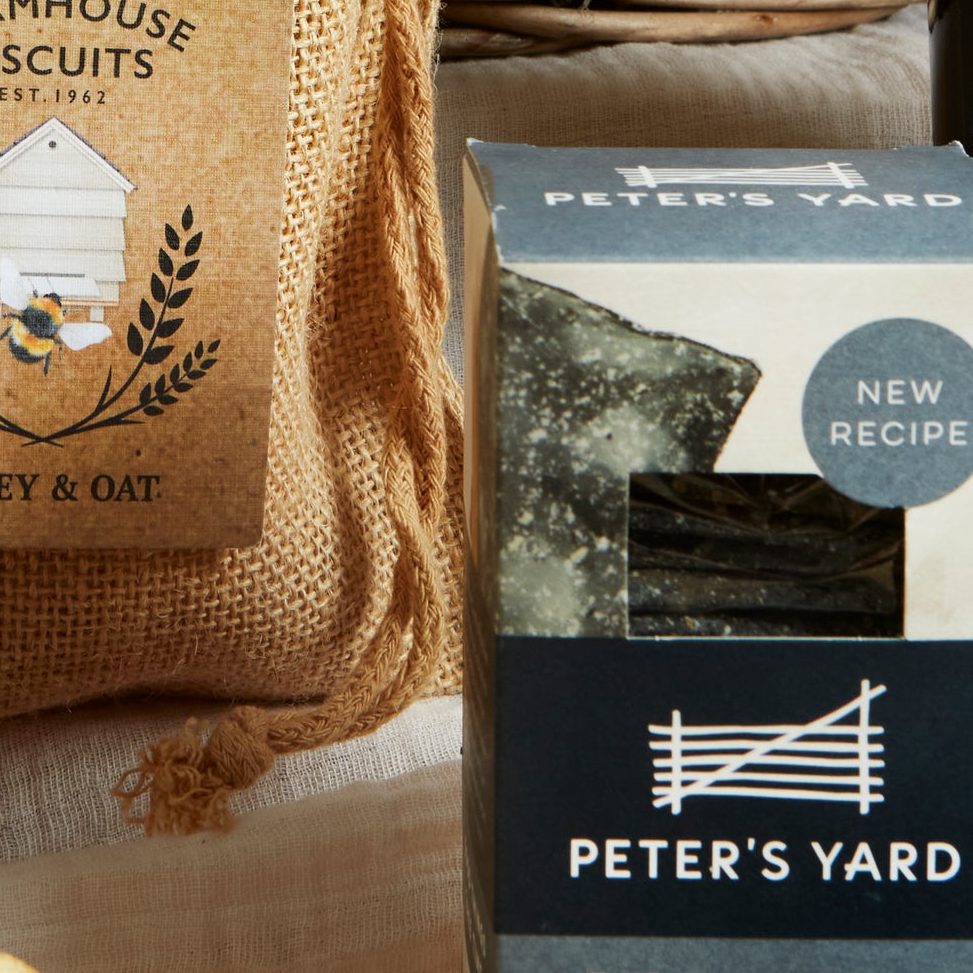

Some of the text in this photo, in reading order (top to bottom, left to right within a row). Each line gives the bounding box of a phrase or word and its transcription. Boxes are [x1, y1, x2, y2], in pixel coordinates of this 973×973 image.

[543, 190, 963, 208] PETER'S YARD
[857, 379, 944, 405] NEW
[829, 421, 968, 446] RECIPE
[51, 473, 78, 502] &
[89, 474, 160, 502] OAT
[569, 838, 961, 882] PETER'S YARD
